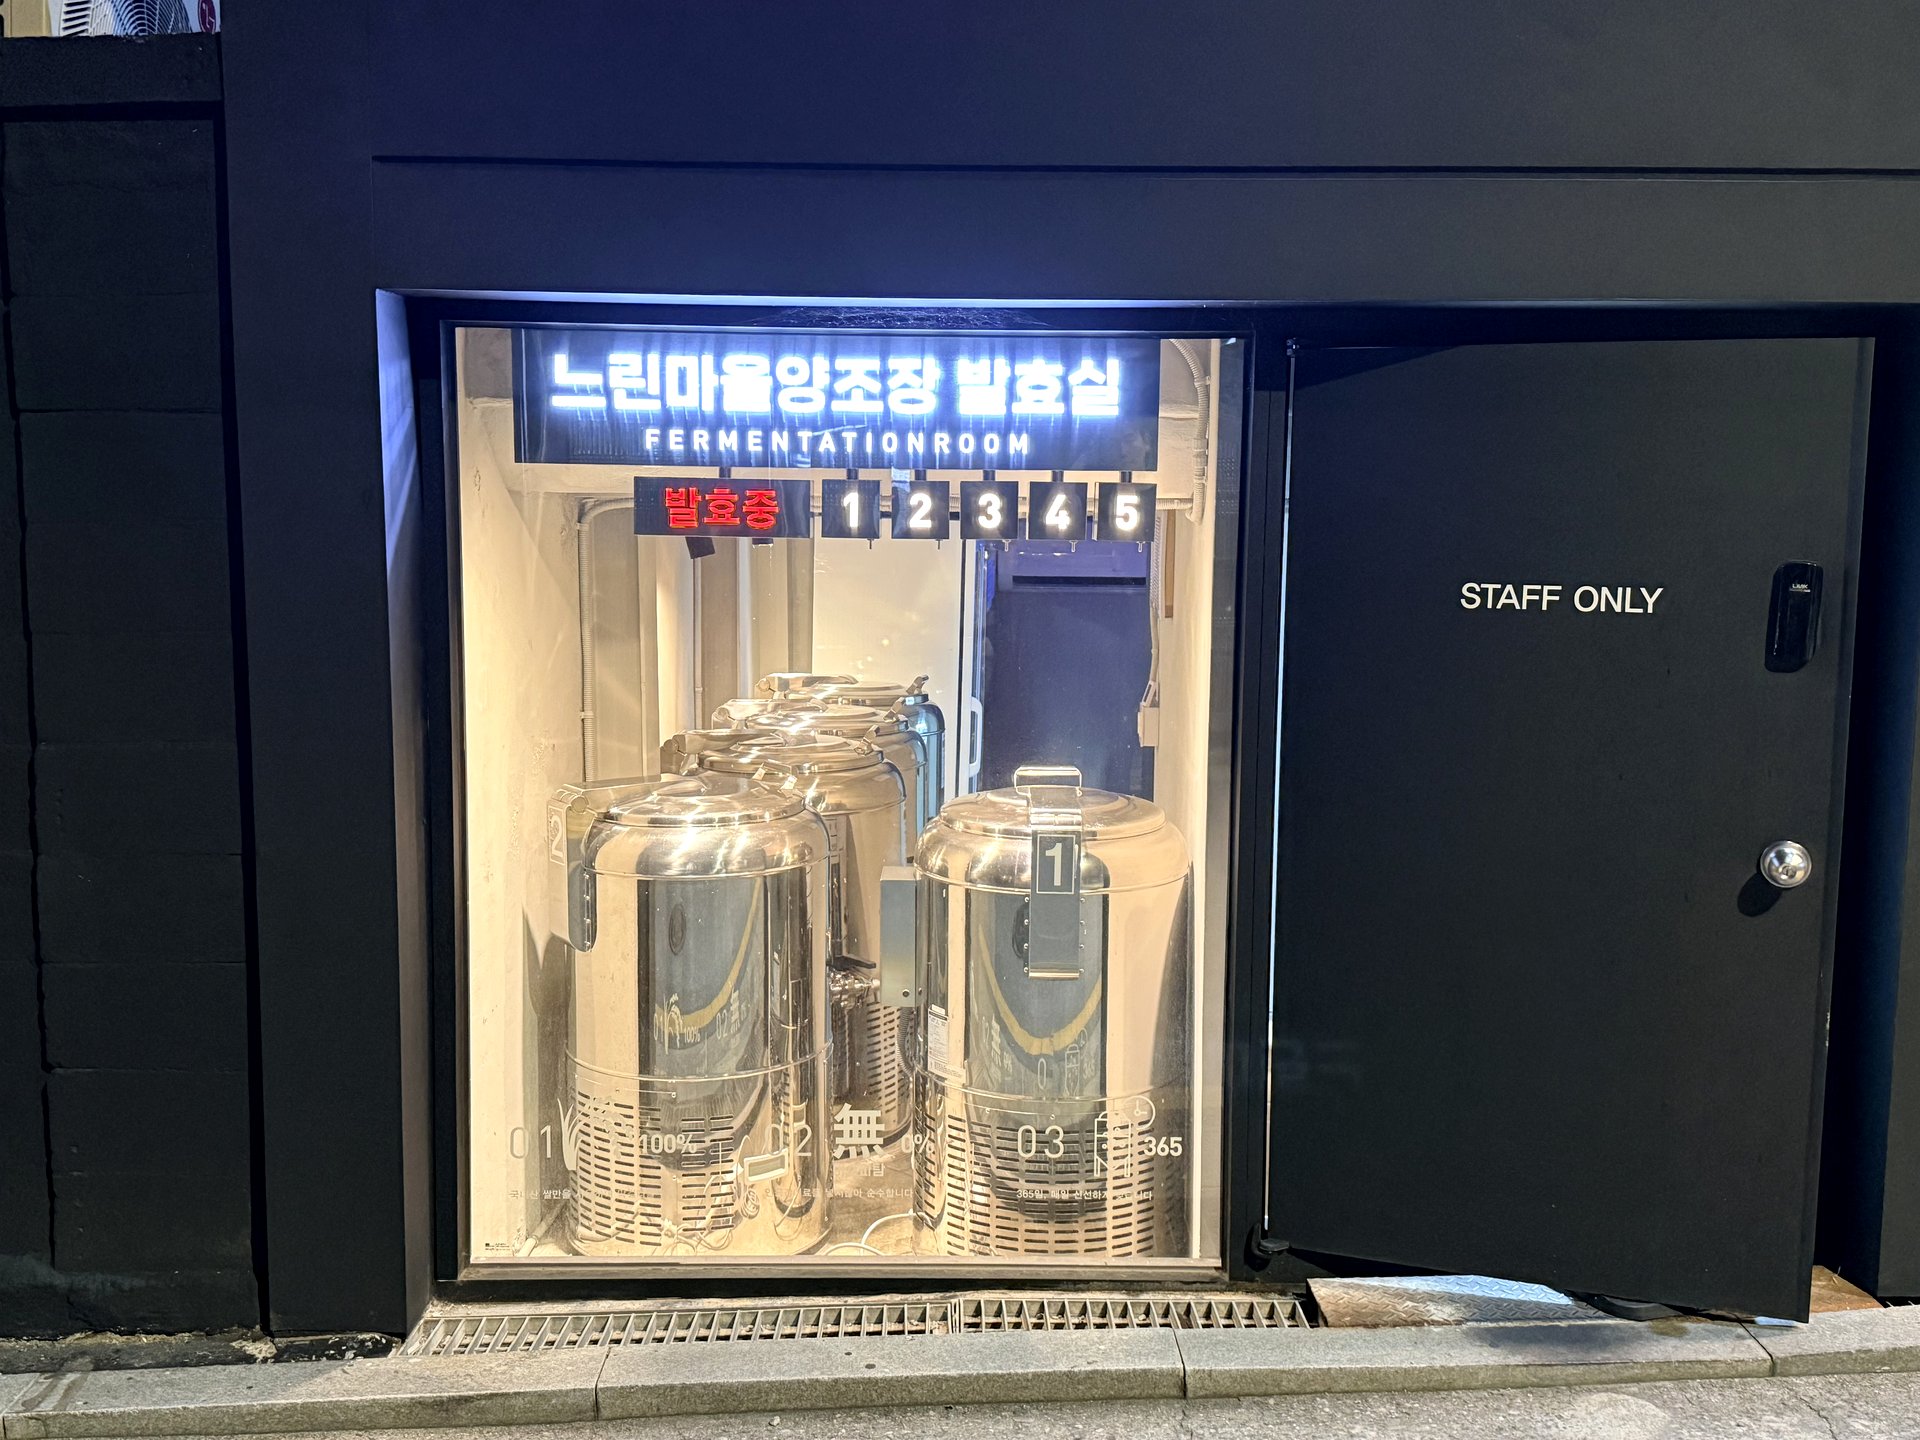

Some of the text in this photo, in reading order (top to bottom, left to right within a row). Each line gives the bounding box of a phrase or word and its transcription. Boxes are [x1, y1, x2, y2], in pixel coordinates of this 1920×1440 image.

[551, 353, 1120, 415] 느린마을양조장 발효실
[664, 486, 780, 530] 발효중
[843, 493, 859, 528] 1
[909, 492, 932, 528] 2
[978, 493, 1001, 529] 3
[1046, 494, 1070, 530] 4
[1115, 494, 1139, 531] 5
[1460, 582, 1664, 614] STAFF ONLY
[1045, 842, 1062, 887] 1
[639, 1133, 697, 1154] 100%
[833, 1102, 886, 1159] 無
[1017, 1124, 1065, 1158] 03
[1143, 1136, 1183, 1157] 365
